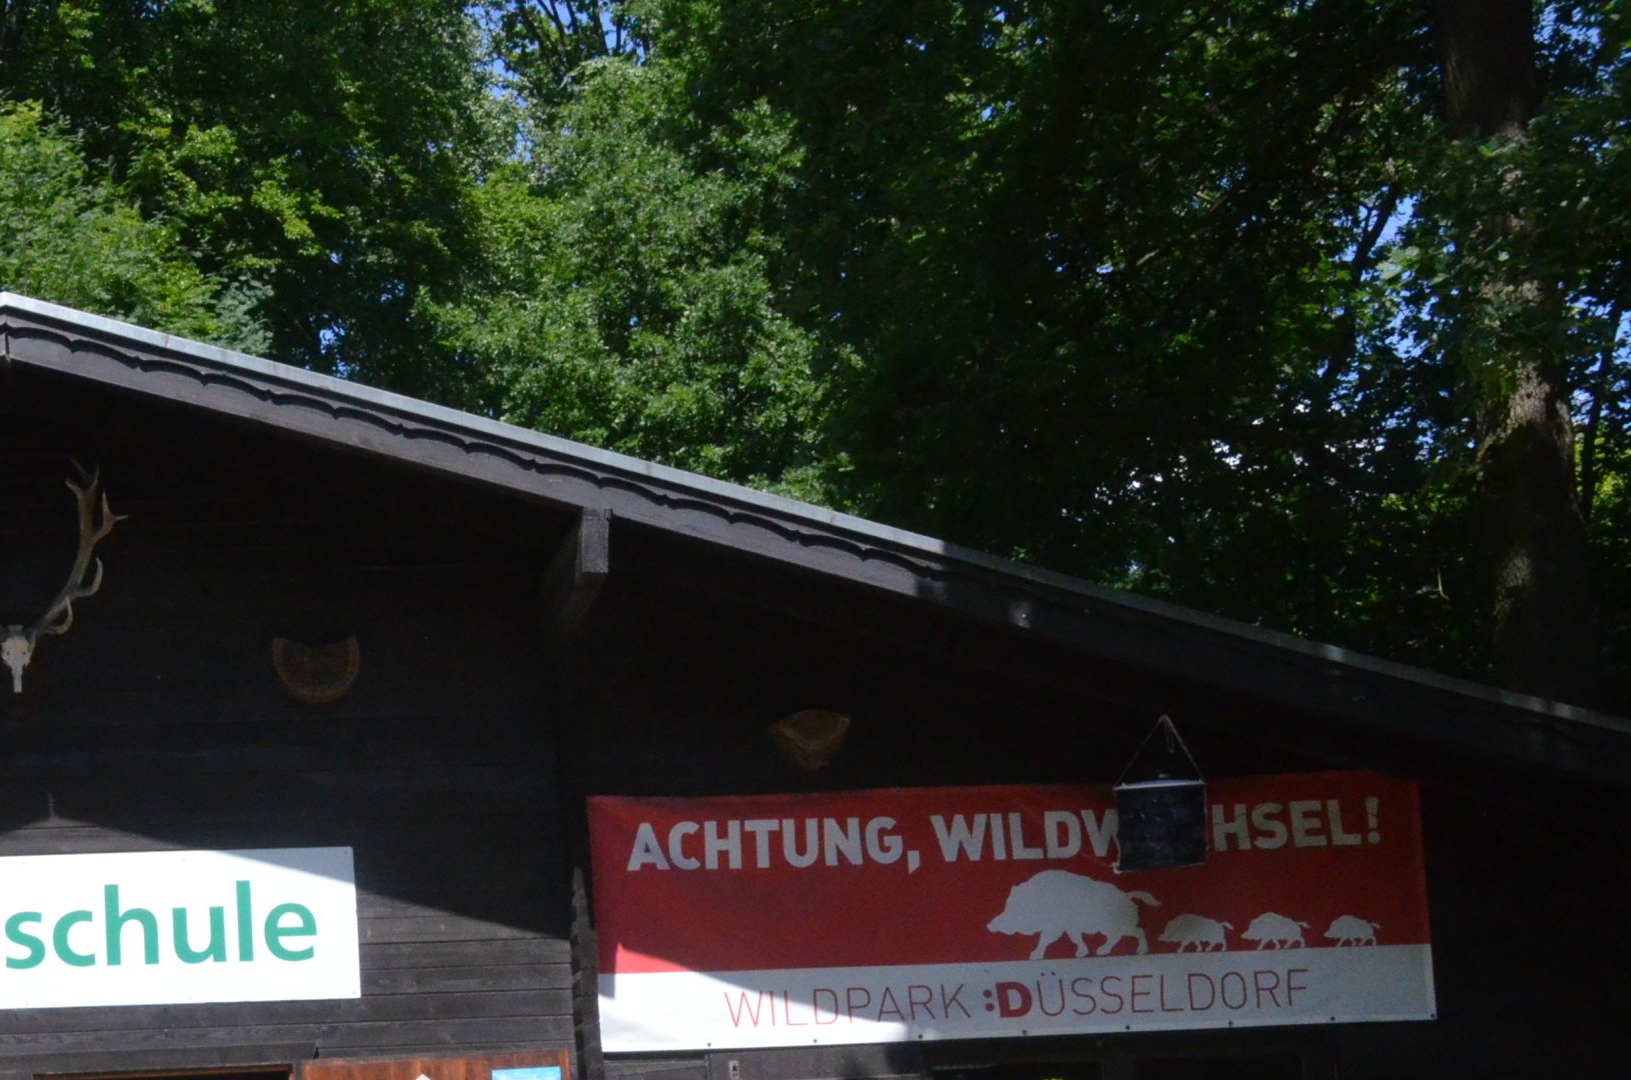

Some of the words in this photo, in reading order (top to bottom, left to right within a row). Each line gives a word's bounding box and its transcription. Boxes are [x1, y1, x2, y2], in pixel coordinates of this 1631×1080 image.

[627, 815, 920, 874] ACHTUNG,
[930, 797, 1379, 863] WILDWHSEL!
[723, 983, 971, 1028] WILDPARK
